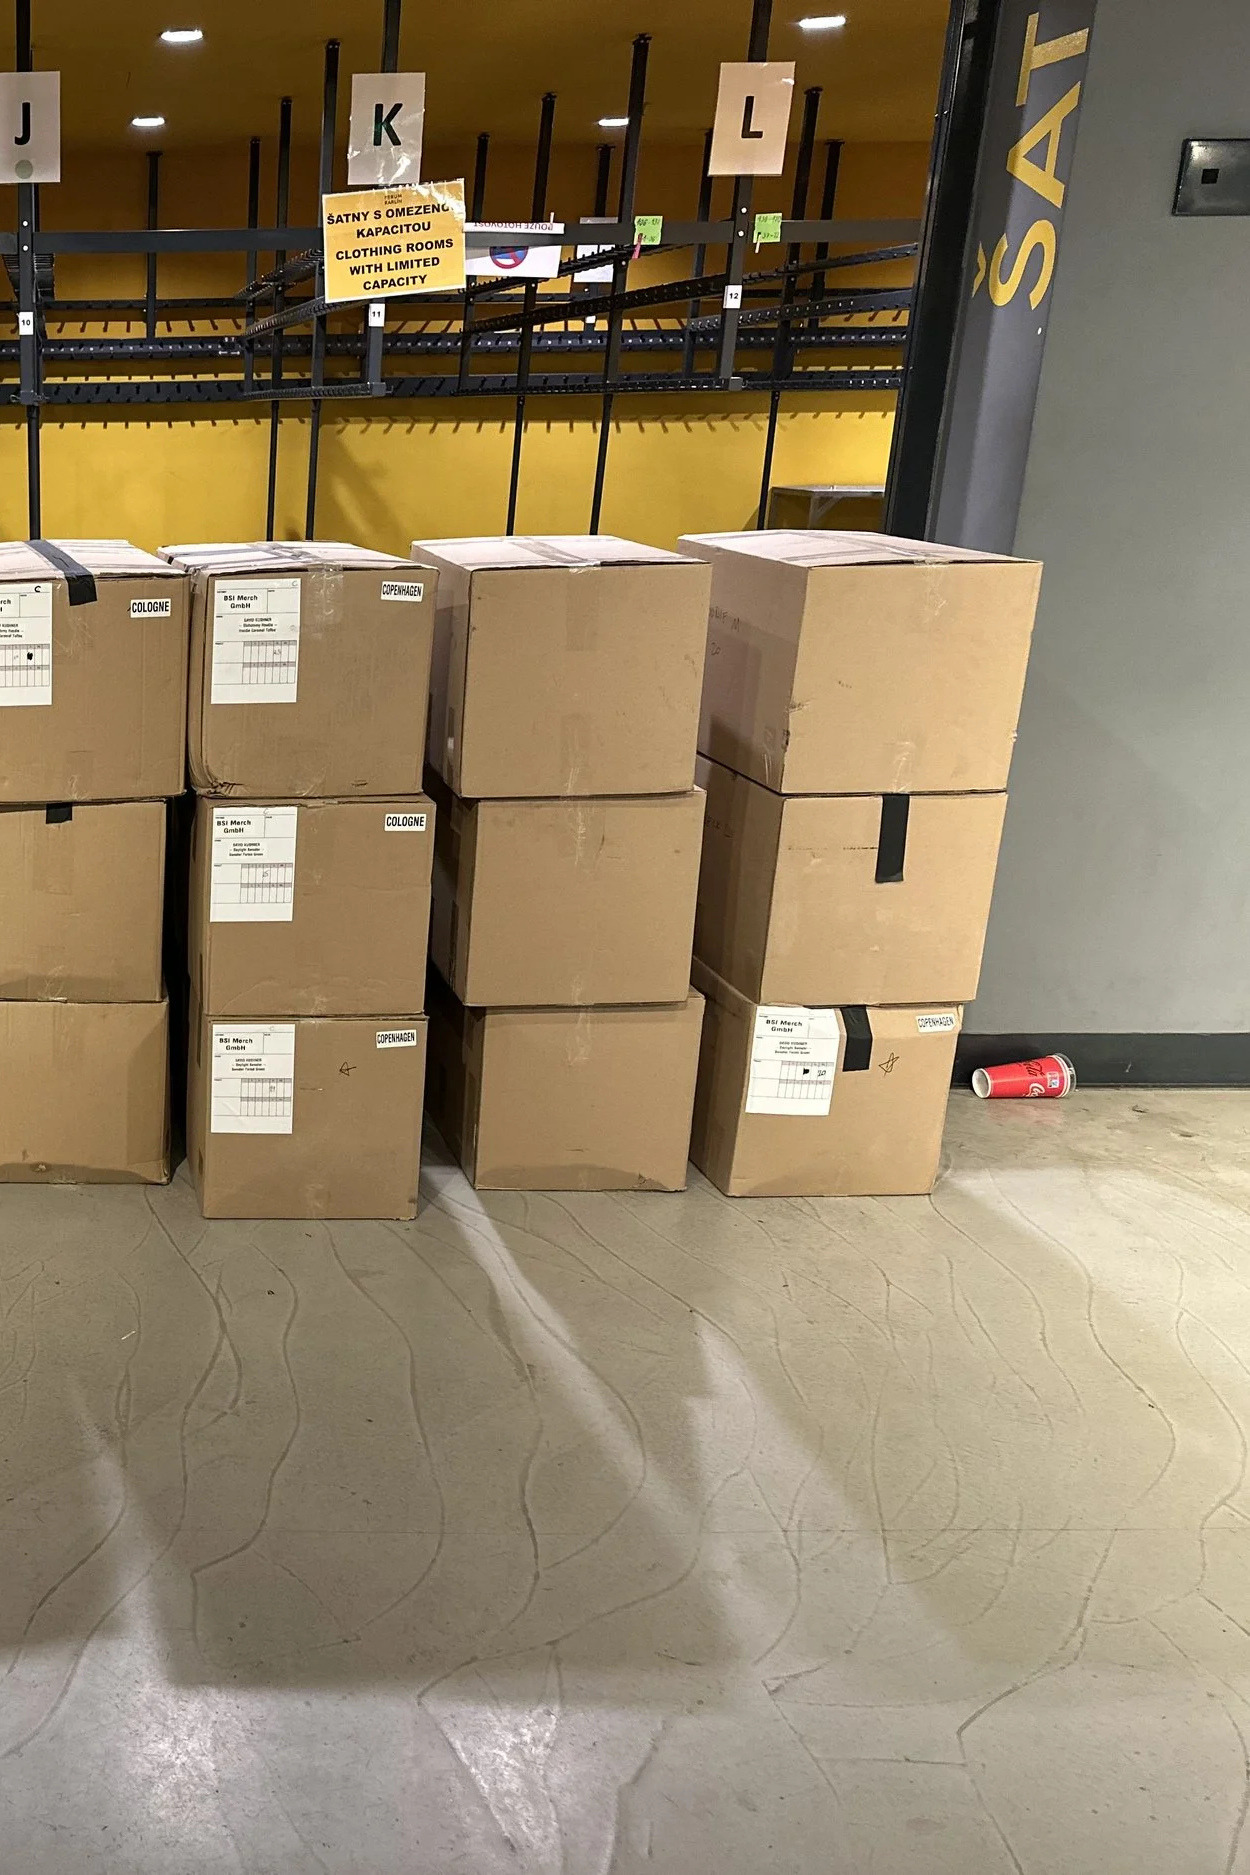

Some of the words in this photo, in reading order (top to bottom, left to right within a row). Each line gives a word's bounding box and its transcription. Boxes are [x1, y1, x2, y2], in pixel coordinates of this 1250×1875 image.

[15, 102, 30, 145] J
[373, 103, 403, 146] K
[741, 96, 763, 139] L
[972, 12, 1090, 310] ŠAT
[327, 211, 369, 225] ŠATNY
[374, 210, 381, 219] S
[356, 221, 431, 238] KAPACITOU
[335, 245, 402, 260] CLOTHING
[406, 238, 454, 252] ROOMS
[350, 263, 383, 276] WITH
[387, 257, 440, 271] LIMITED
[363, 275, 427, 290] CAPACITY
[34, 585, 42, 593] C
[382, 584, 422, 597] COPENHAGEN
[132, 601, 170, 613] COLOGNE
[386, 816, 425, 827] COLOGNE
[918, 1016, 954, 1028] COPENHAGEN
[377, 1032, 415, 1044] COPENHAGEN
